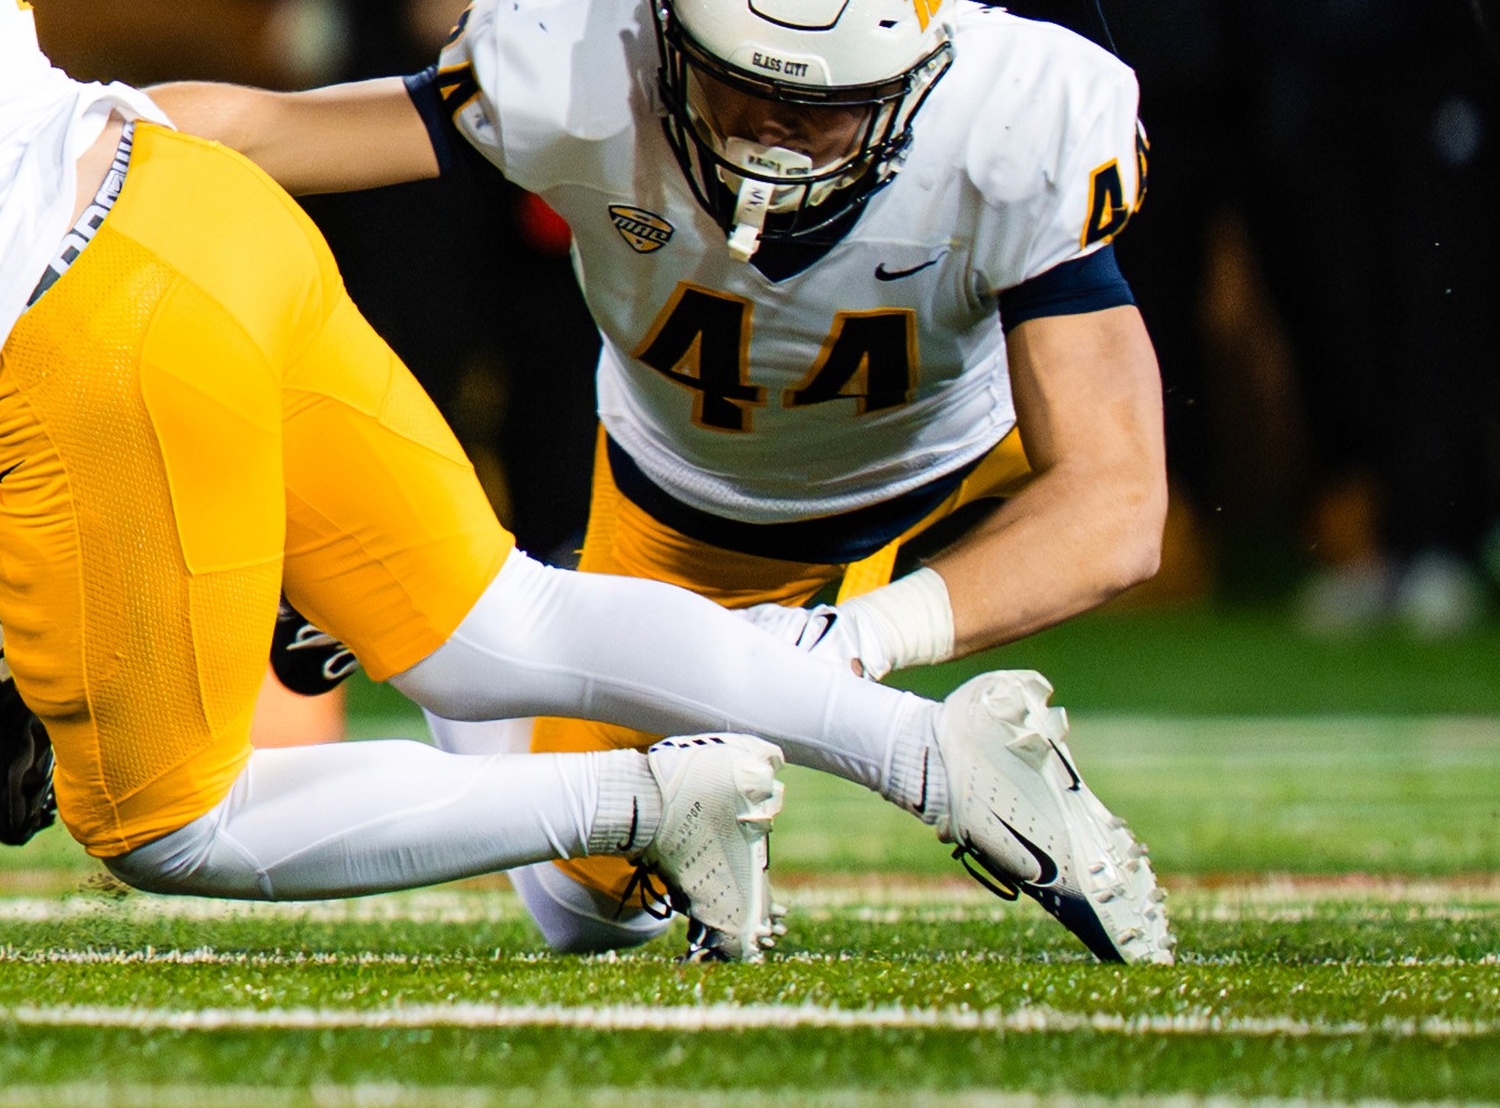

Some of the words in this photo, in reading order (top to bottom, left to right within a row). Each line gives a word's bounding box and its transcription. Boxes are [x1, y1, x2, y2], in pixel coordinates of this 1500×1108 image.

[752, 52, 782, 72] GLASS
[784, 61, 809, 77] CITY
[630, 281, 919, 432] 44
